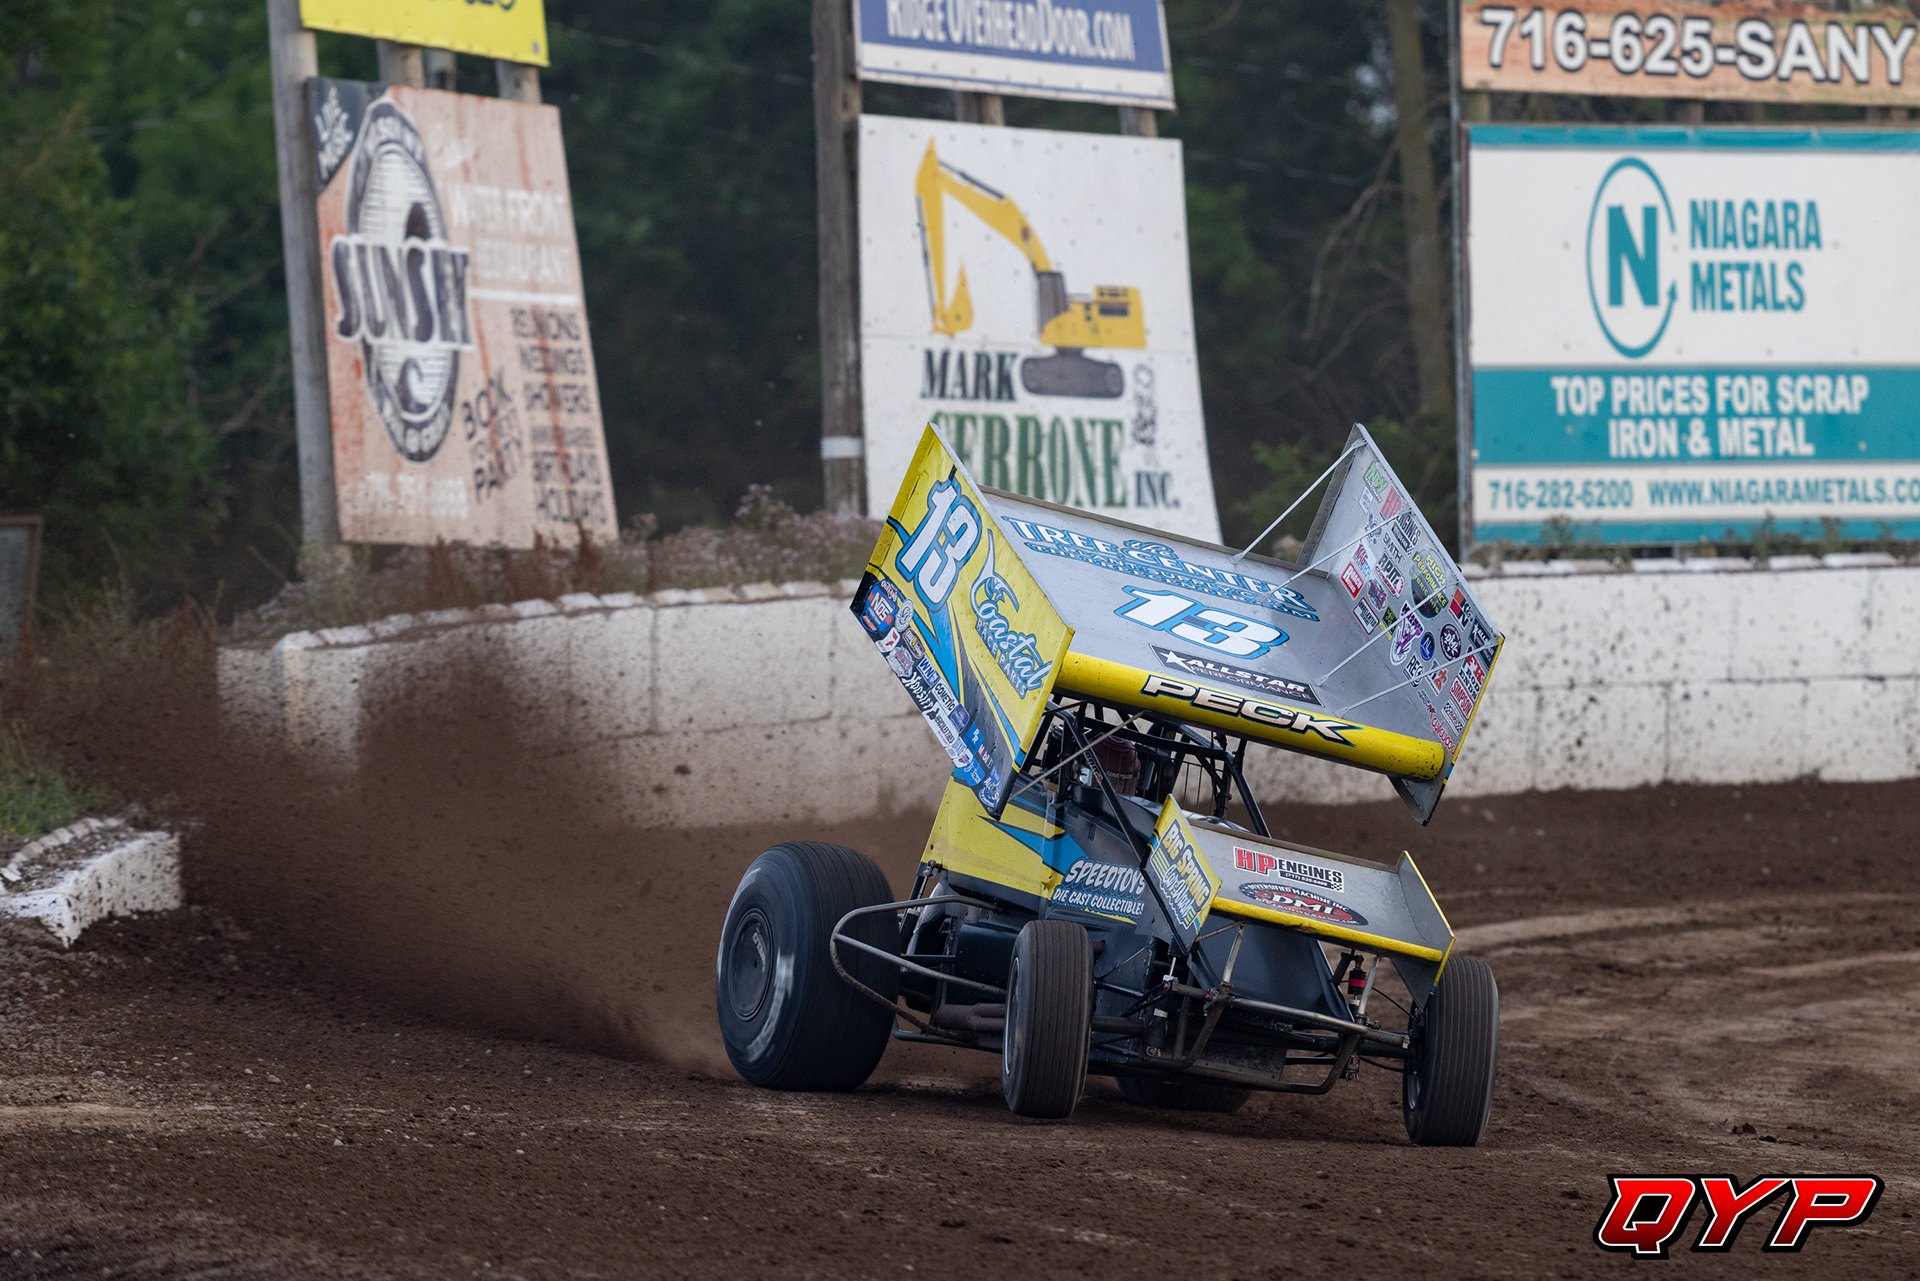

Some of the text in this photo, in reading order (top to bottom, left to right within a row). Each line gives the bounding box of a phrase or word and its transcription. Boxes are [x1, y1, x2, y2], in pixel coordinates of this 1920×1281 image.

[1479, 6, 1919, 84] 716-625-SANY
[1688, 199, 1823, 251] NIAGARA
[1691, 261, 1806, 312] METALS
[920, 348, 1020, 402] MARK
[1551, 374, 1870, 416] TOP PRICES FOR SCRAP
[1608, 418, 1816, 459] IRON & METAL
[1134, 470, 1181, 508] INC.
[1489, 479, 1634, 510] 716-282-6200
[898, 482, 979, 608] 13
[1004, 517, 1118, 553] TREE
[1122, 549, 1316, 611] CENTER
[1426, 554, 1447, 586] HIGH
[1116, 587, 1287, 657] 13
[976, 617, 1028, 698] RACE PARTS
[1186, 659, 1309, 693] ALLSTAR
[901, 672, 935, 710] Hoosier
[1451, 681, 1473, 717] SIMPSON
[1459, 669, 1477, 700] ENDS
[1466, 668, 1480, 692] ROD
[1141, 675, 1361, 747] PECK
[1065, 859, 1145, 895] SPEEDTOYS
[1162, 823, 1210, 907] BIG SPRING
[1235, 848, 1343, 884] HP ENGINES
[1053, 888, 1069, 902] DIE
[1069, 891, 1092, 906] CAST
[1271, 893, 1336, 915] DMI
[1292, 888, 1332, 904] MACHINE
